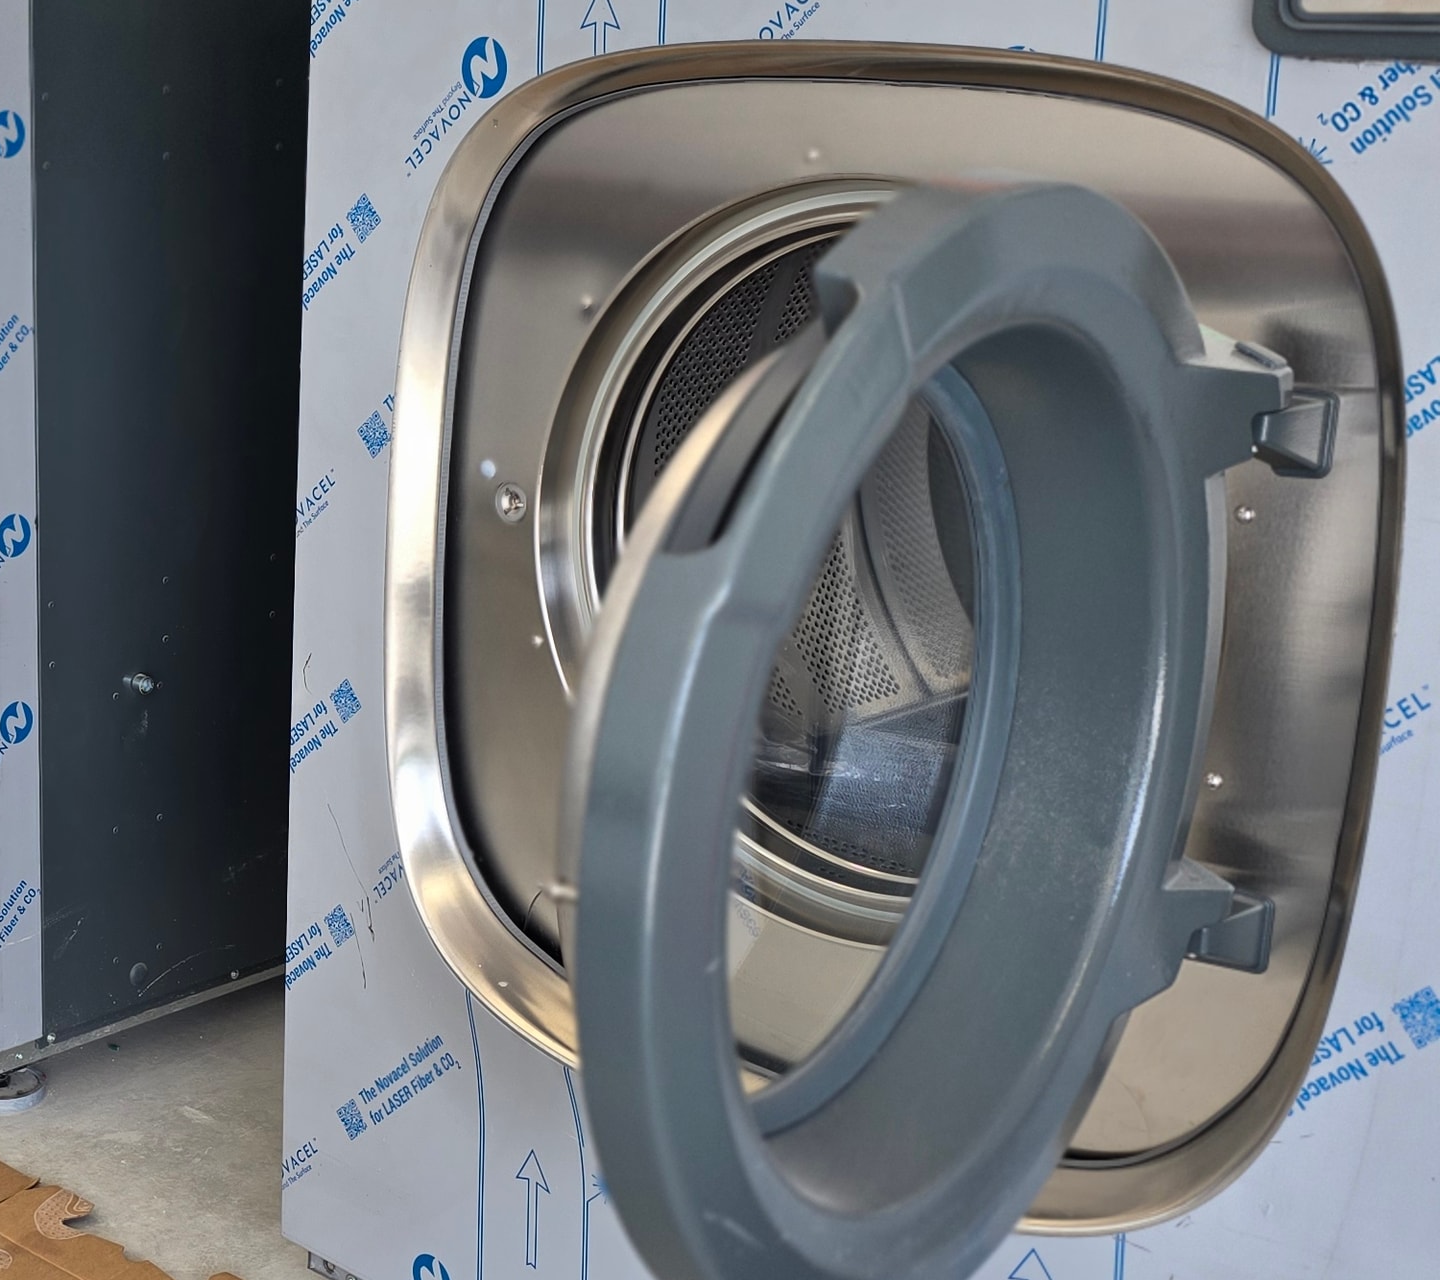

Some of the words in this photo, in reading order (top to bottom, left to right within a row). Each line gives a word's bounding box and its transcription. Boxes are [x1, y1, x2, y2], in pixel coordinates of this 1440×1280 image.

[793, 2, 820, 30] Surface
[310, 5, 346, 58] Novacel
[442, 81, 462, 107] Beyond
[1357, 86, 1379, 106] &
[432, 104, 444, 118] The
[1350, 85, 1433, 154] Solution
[405, 91, 472, 169] NOVACEL
[413, 116, 433, 140] Surface
[328, 223, 343, 244] for
[335, 243, 355, 265] The
[302, 262, 337, 311] Novacel
[8, 342, 18, 352] &
[311, 501, 329, 520] Surface
[313, 700, 327, 718] for
[319, 720, 338, 739] The
[290, 734, 322, 773] Novacel
[0, 914, 19, 942] Fiber
[17, 905, 25, 914] &
[307, 922, 321, 939] for
[314, 942, 332, 960] The
[285, 955, 316, 990] Novacel
[1354, 1012, 1384, 1036] for
[1365, 1041, 1405, 1066] The
[359, 1088, 377, 1104] The
[374, 1057, 411, 1093] Novacel
[409, 1035, 443, 1066] Solution
[369, 1109, 384, 1125] for
[382, 1085, 413, 1115] LASER
[410, 1070, 435, 1094] Fiber
[433, 1063, 443, 1077] &
[1296, 1058, 1369, 1111] Novacel
[281, 1142, 318, 1178] VACEL
